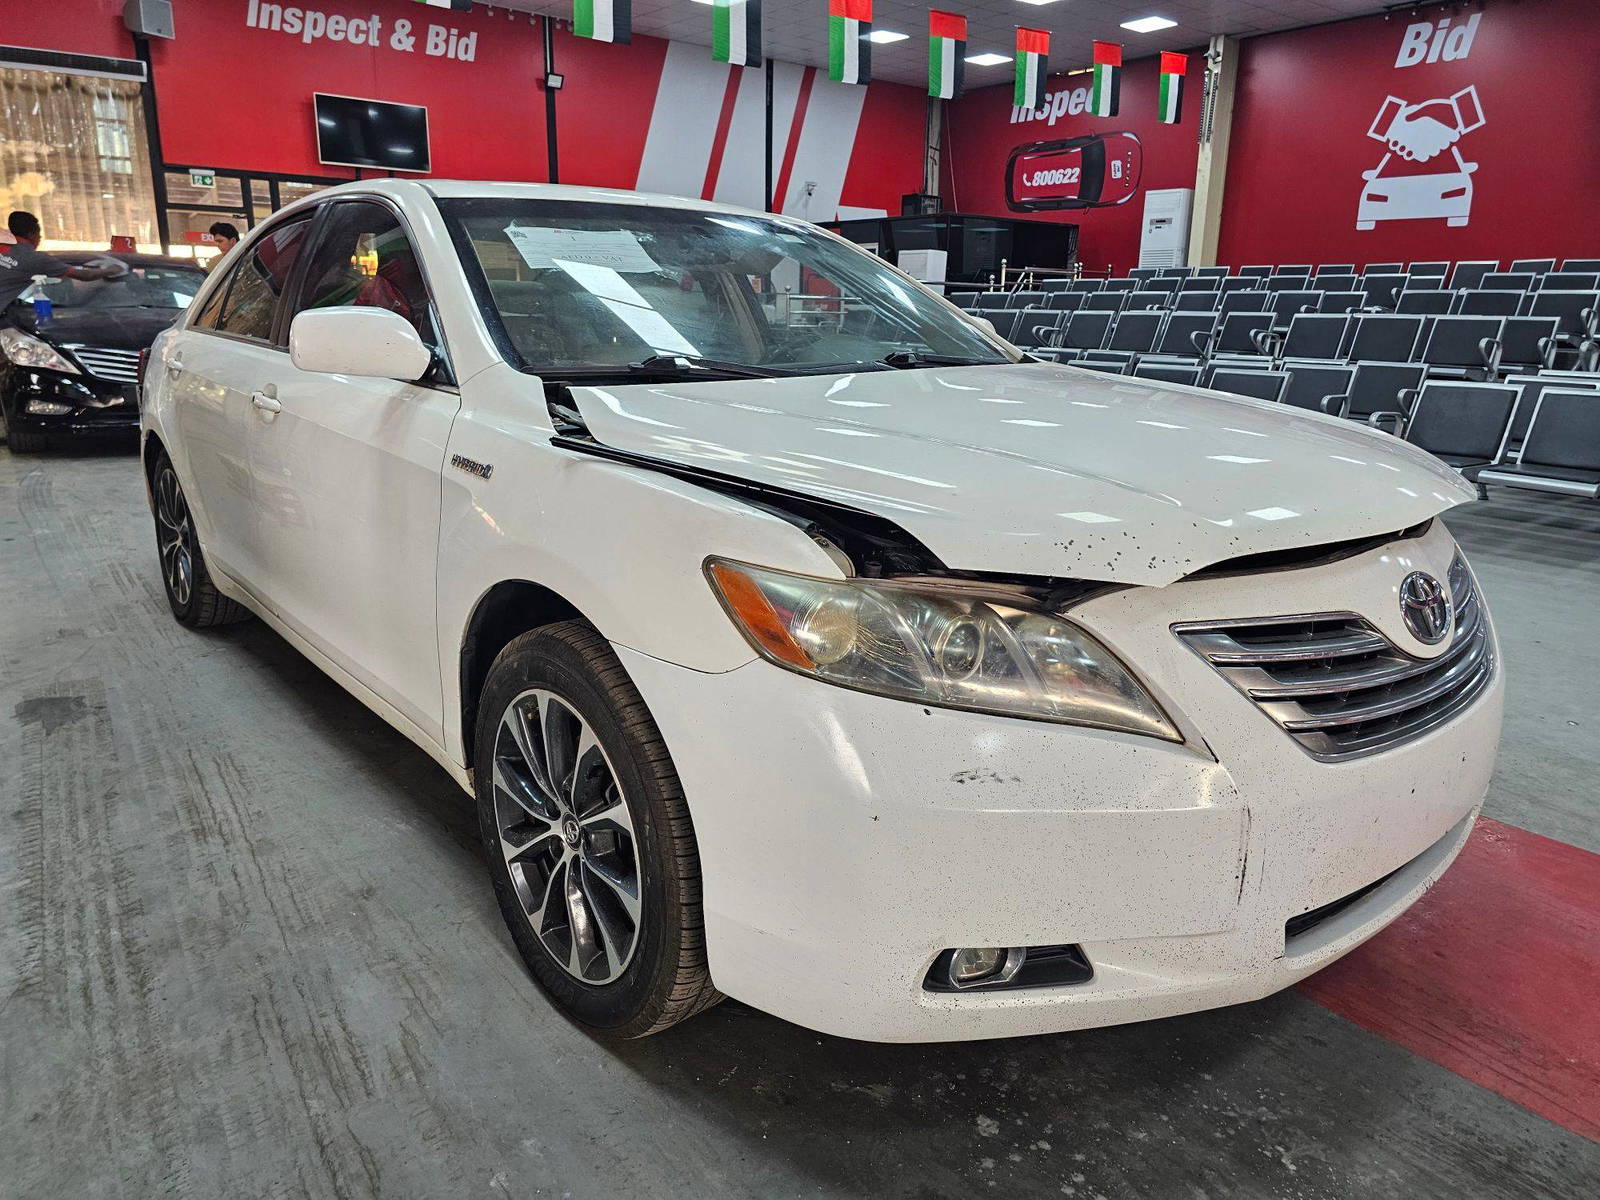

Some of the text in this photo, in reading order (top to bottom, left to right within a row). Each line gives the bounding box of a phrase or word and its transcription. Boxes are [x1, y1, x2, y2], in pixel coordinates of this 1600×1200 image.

[246, 0, 478, 62] Inspect & Bid
[1394, 12, 1482, 69] Bid
[1032, 167, 1080, 187] 800622
